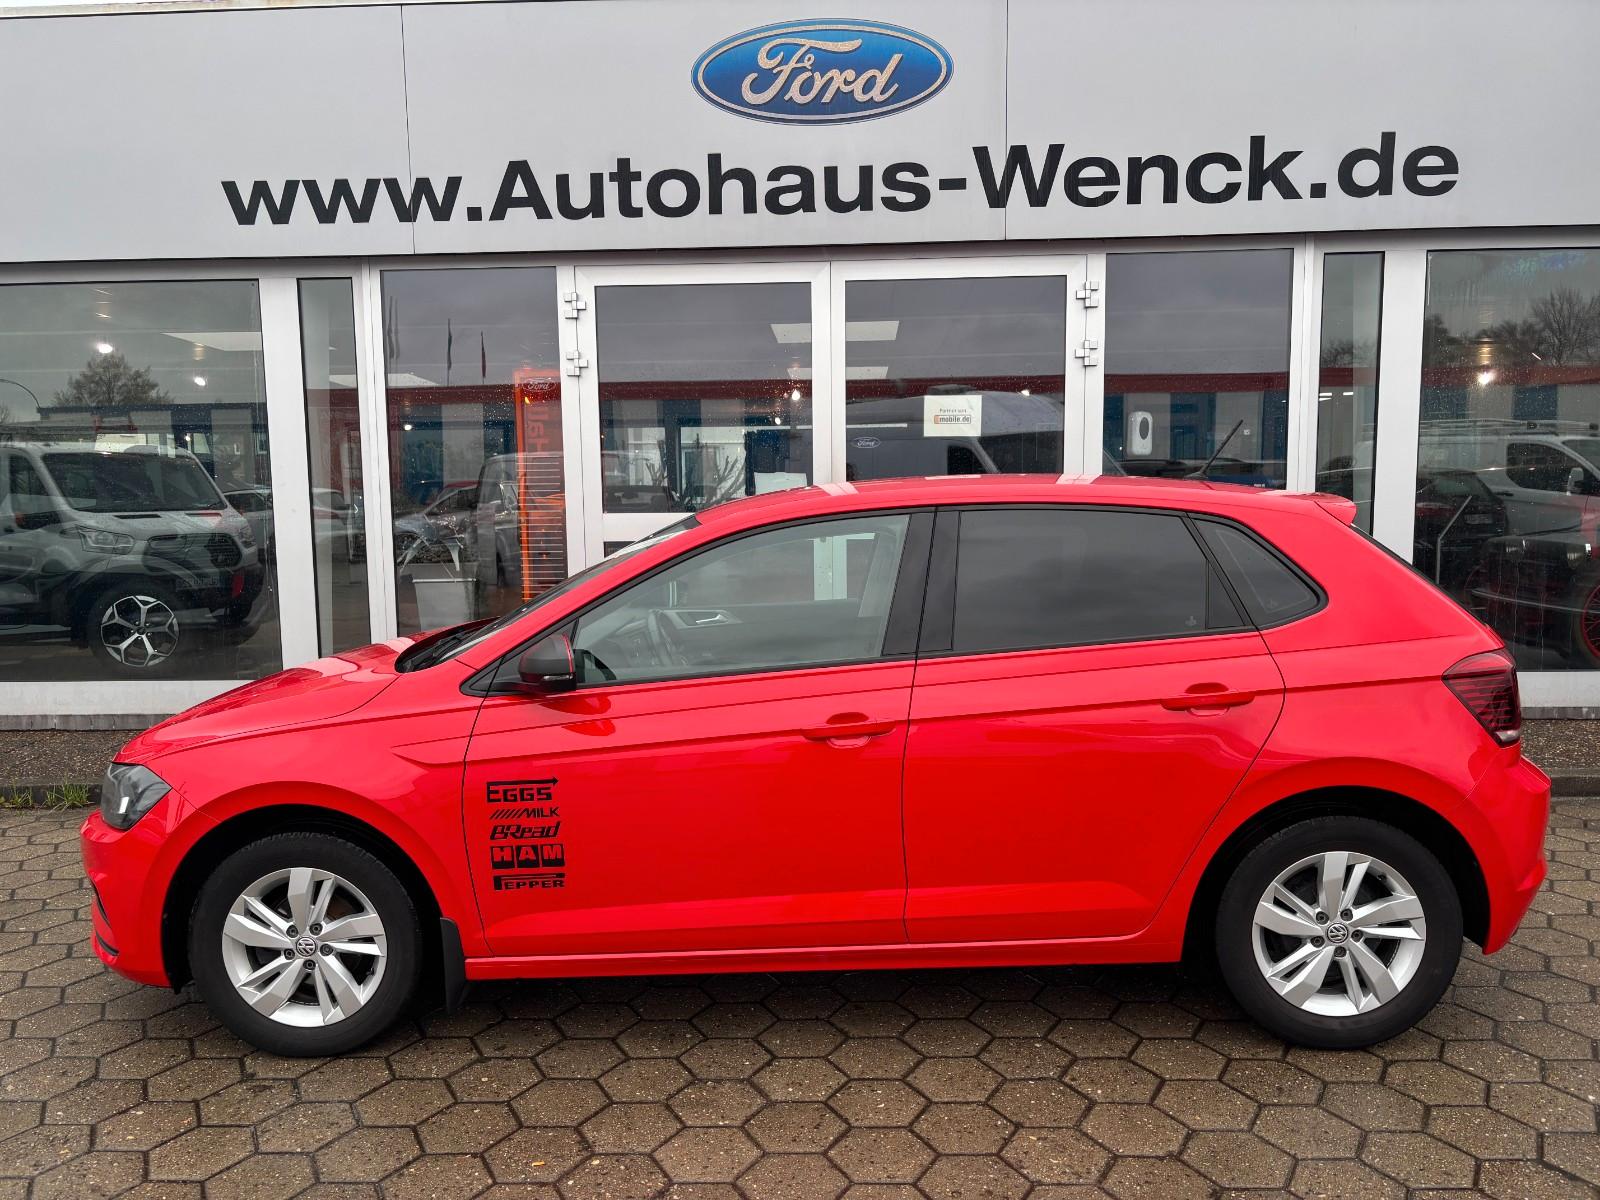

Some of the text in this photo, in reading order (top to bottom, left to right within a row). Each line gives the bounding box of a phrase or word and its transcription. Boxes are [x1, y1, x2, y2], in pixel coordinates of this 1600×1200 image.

[741, 37, 905, 105] Ford
[221, 131, 1459, 226] www.Autohaus-Wenck.de
[486, 778, 557, 803] EGGS
[518, 807, 560, 819] MILK
[490, 844, 565, 869] HAM
[493, 873, 565, 891] PEPPER
